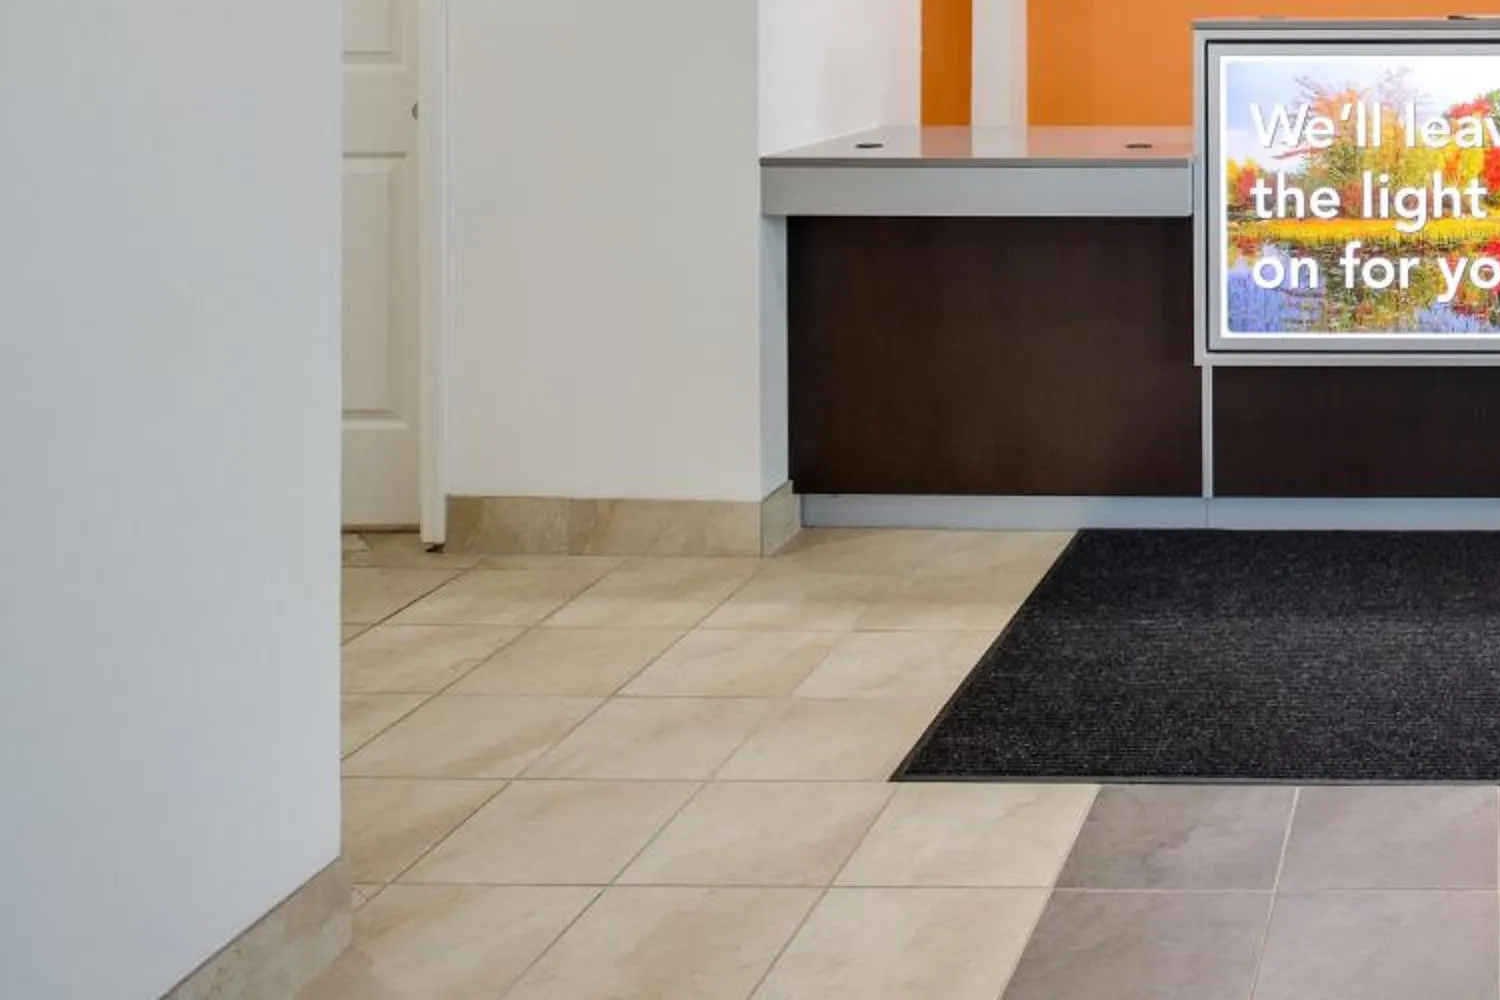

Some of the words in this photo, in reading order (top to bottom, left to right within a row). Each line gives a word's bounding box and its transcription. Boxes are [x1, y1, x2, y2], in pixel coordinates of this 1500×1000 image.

[1250, 170, 1341, 219] the
[1362, 170, 1488, 233] light
[1252, 253, 1319, 289] on
[1339, 241, 1419, 289] for
